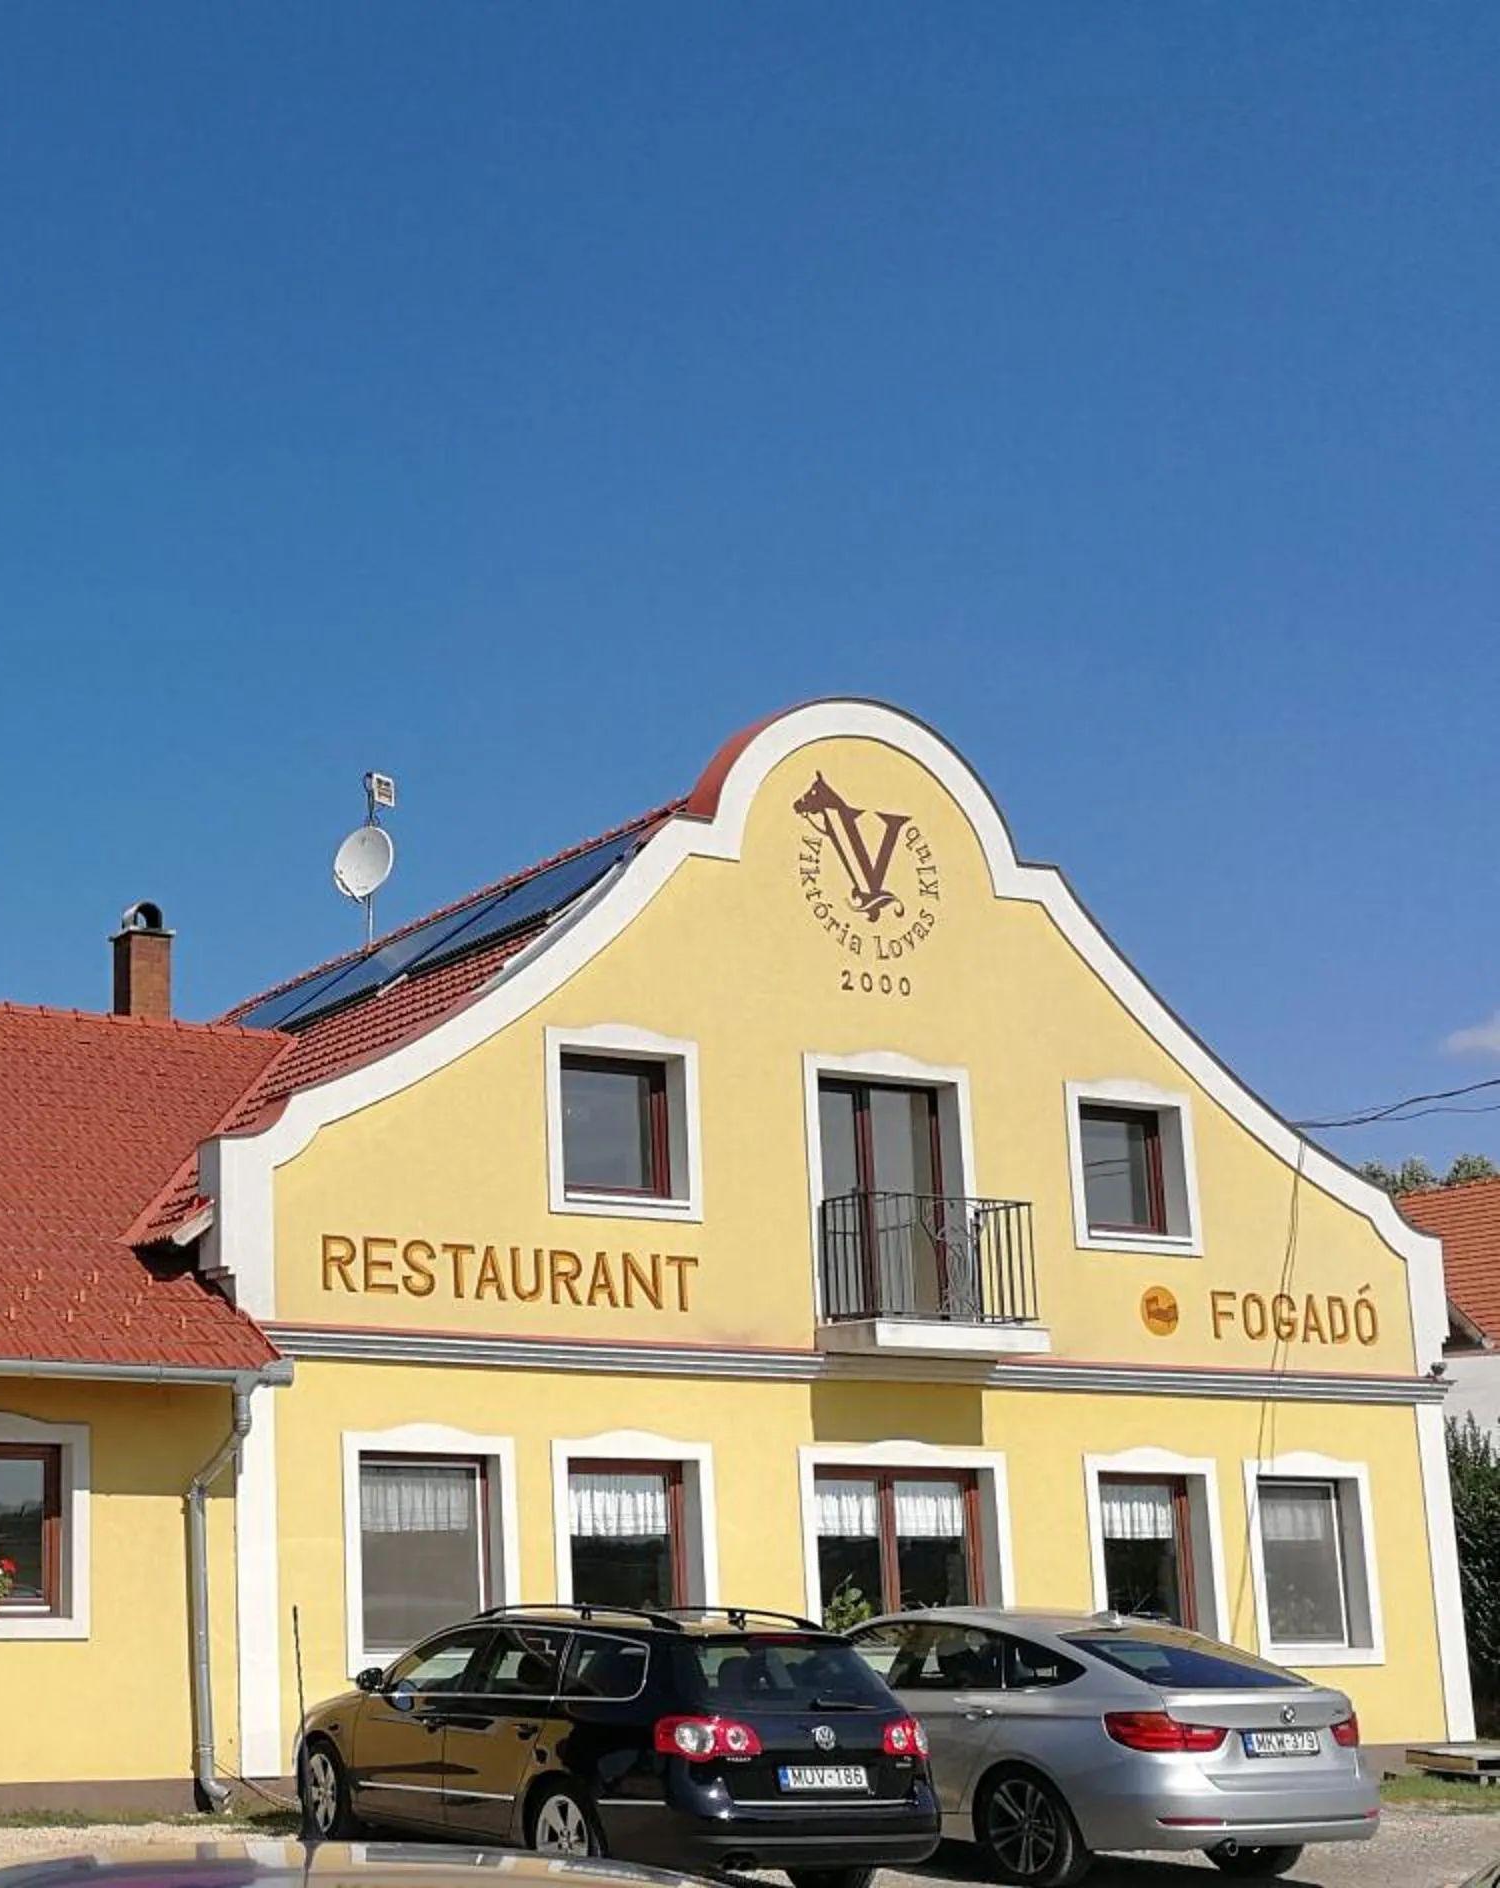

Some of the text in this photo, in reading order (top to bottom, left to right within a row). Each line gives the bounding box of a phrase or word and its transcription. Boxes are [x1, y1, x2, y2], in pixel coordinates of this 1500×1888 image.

[799, 825, 940, 961] Viktória Lovas Klub
[841, 969, 912, 997] 2000
[321, 1233, 700, 1313] RESTAURANT
[1210, 1283, 1380, 1346] FOGADÓ
[790, 1767, 865, 1785] MUV-186
